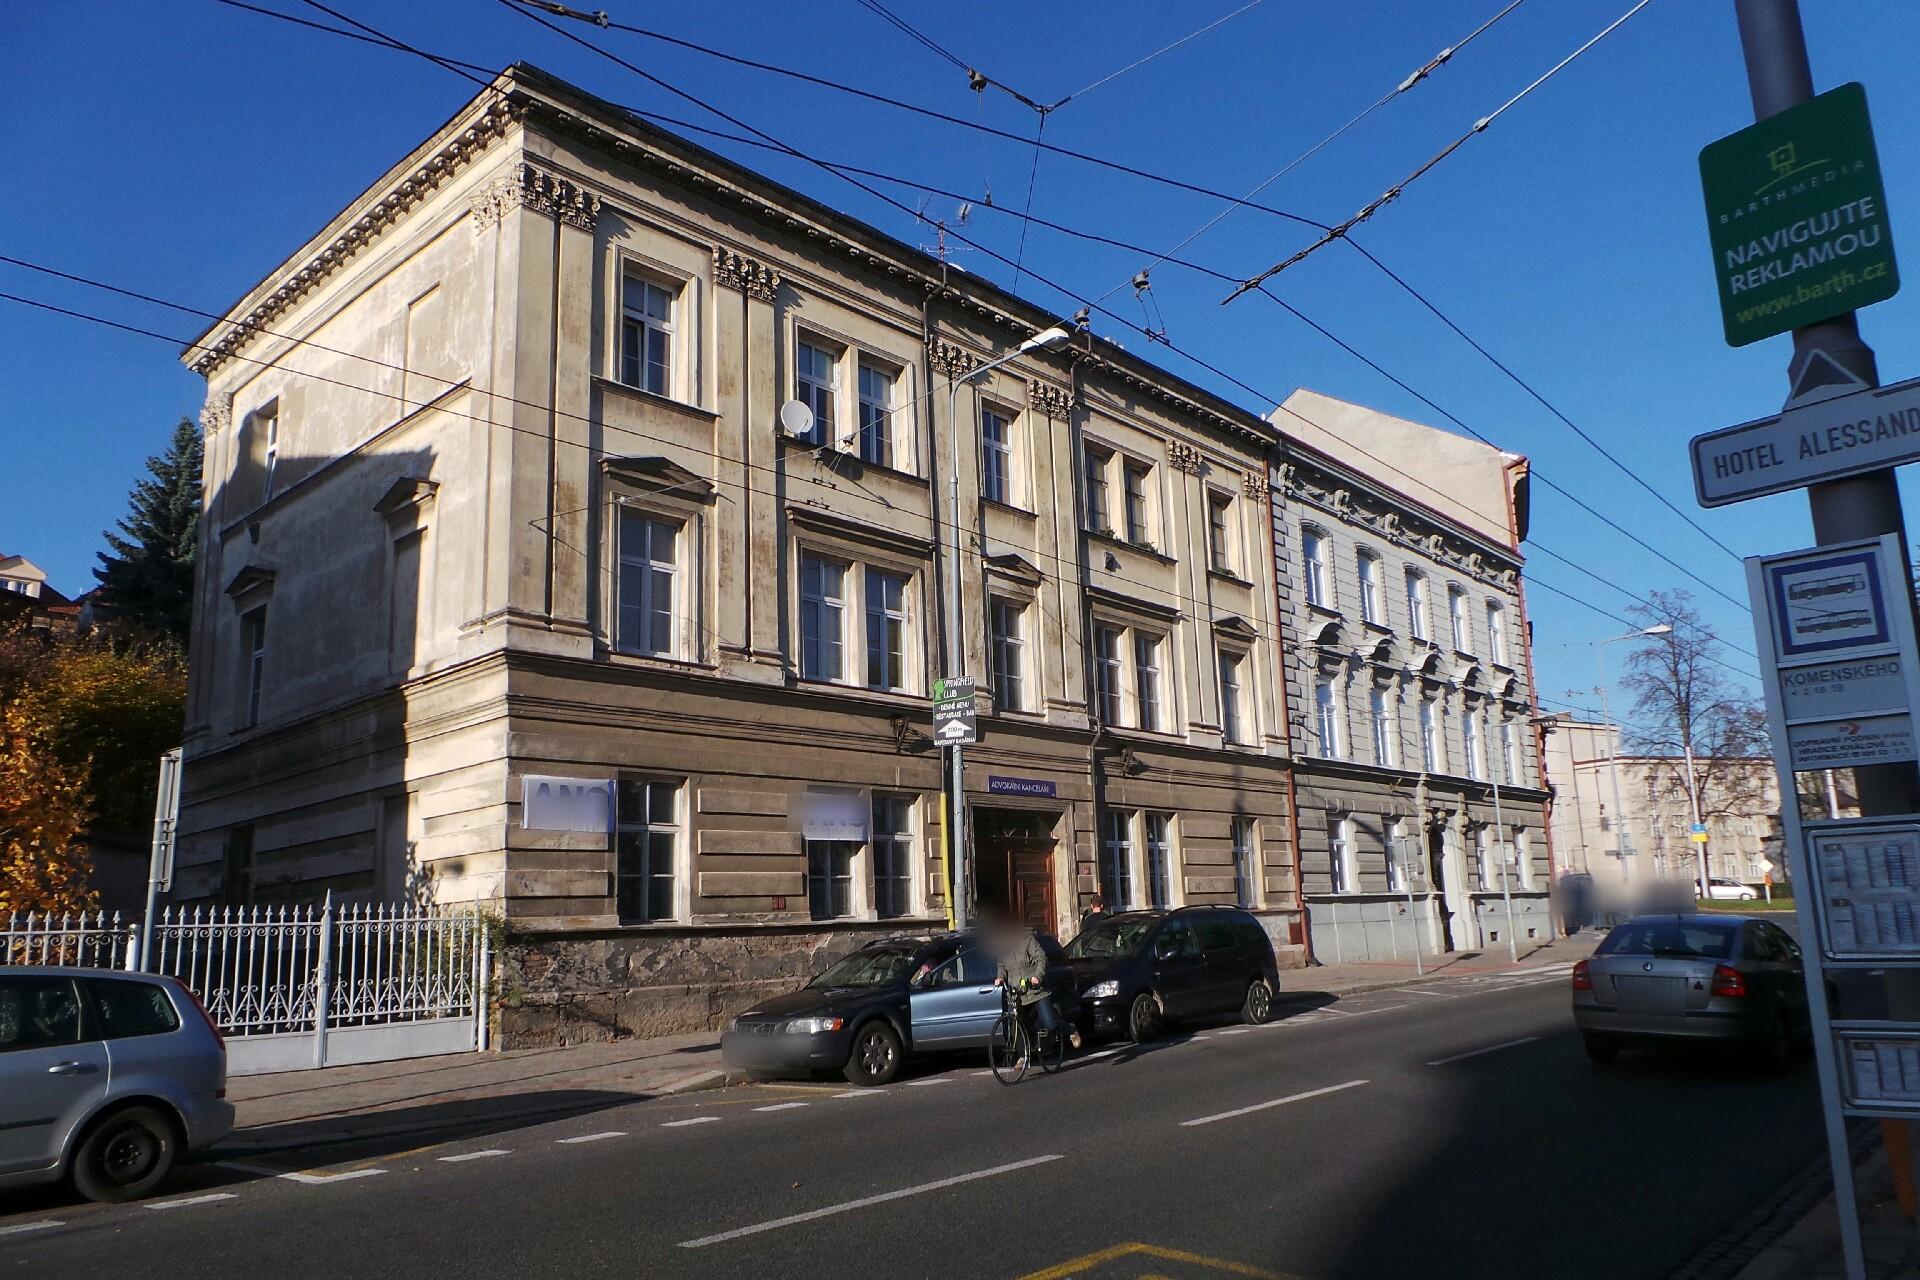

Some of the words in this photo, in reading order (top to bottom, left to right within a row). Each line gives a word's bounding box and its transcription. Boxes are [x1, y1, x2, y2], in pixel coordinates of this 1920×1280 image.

[1726, 196, 1876, 269] NAVIGUJTE
[1730, 223, 1881, 295] REKLAMOU
[1736, 261, 1888, 324] www.barth.cz
[1714, 443, 1784, 479] HOTEL
[943, 689, 958, 699] CLUB
[1784, 661, 1900, 687] KOMENSKÉHO
